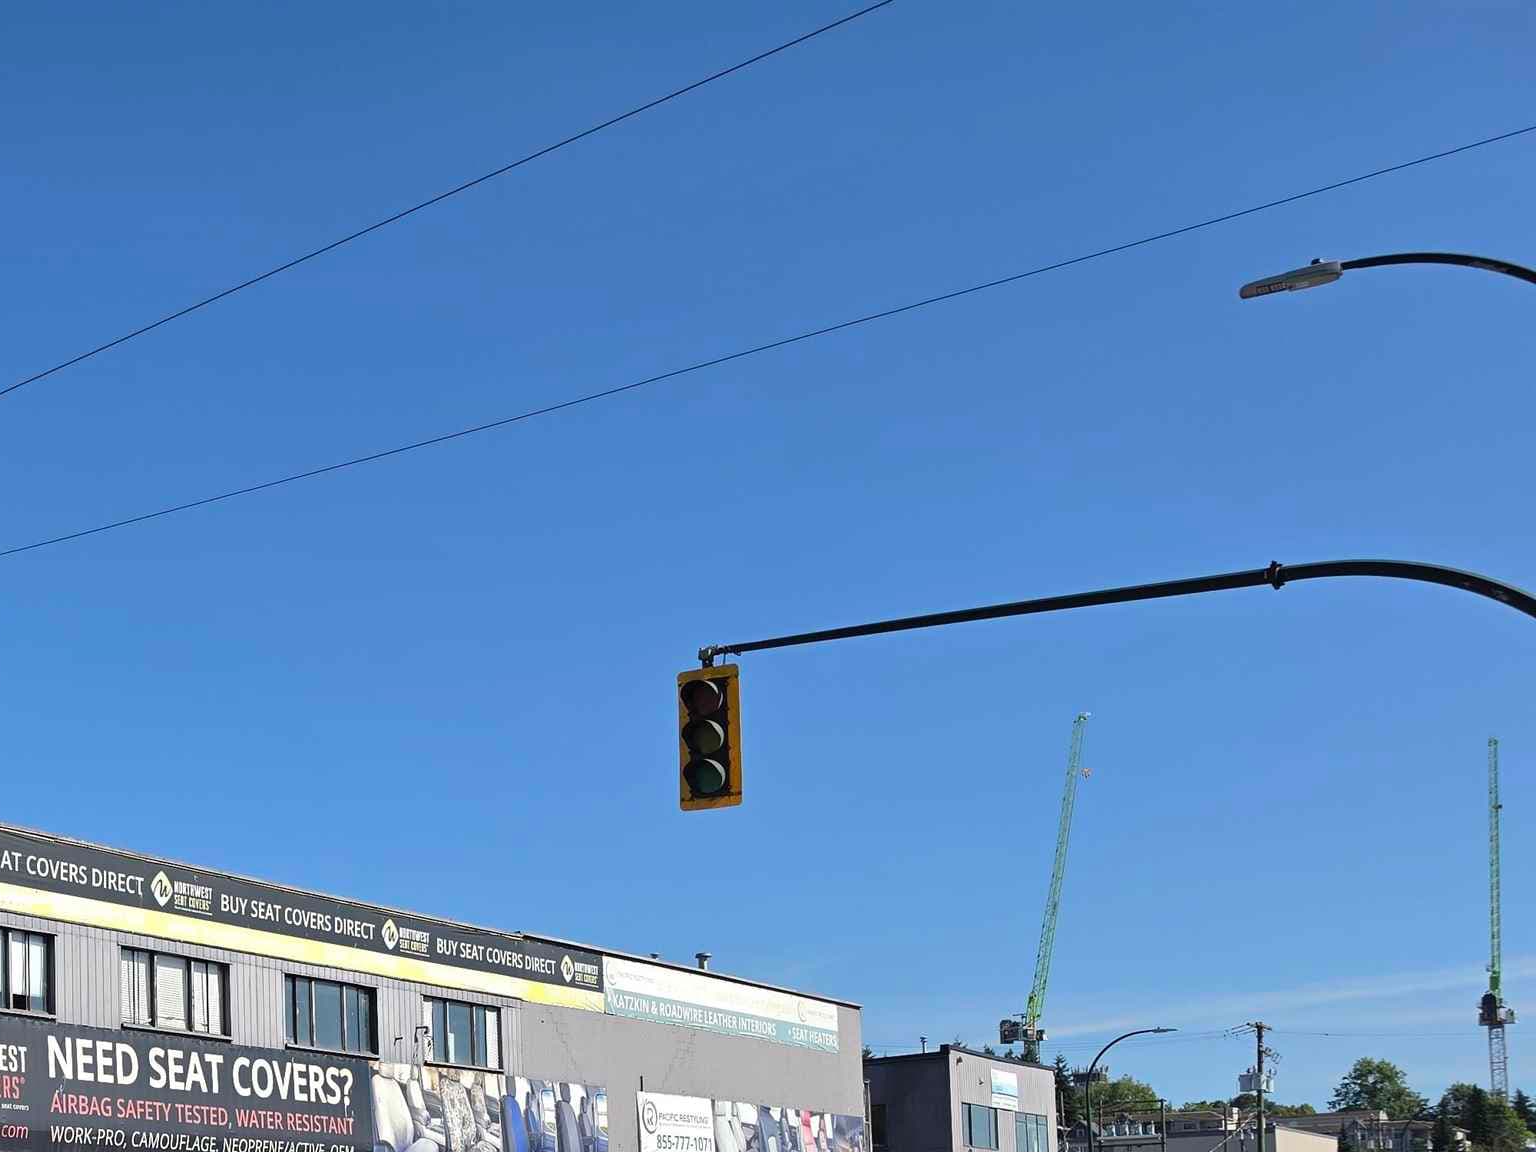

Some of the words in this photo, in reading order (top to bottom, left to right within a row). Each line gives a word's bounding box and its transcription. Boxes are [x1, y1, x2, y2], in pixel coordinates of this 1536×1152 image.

[26, 855, 88, 885] COVERS
[91, 866, 145, 895] DIRECT
[174, 880, 212, 900] NORTHWEST
[174, 895, 187, 906] SEAT
[188, 898, 210, 911] COVERS
[221, 893, 249, 915] BUY
[250, 900, 281, 922] SEAT
[284, 907, 332, 931] COVERS
[334, 917, 375, 941] DIRECT
[399, 927, 430, 943] NORTHWEST
[436, 936, 458, 956] BUY
[460, 943, 484, 962] SEAT
[486, 947, 523, 970] COVERS
[525, 955, 557, 976] DIRECT
[574, 962, 598, 975] NORTHWEST
[615, 995, 649, 1015] KATZKIN
[651, 1003, 658, 1014] &
[659, 1003, 703, 1023] ROADWIRE
[704, 1010, 737, 1028] LEATHER
[738, 1016, 776, 1035] INTERIORS
[791, 1027, 808, 1041] SEAT
[46, 1034, 140, 1086] NEED
[148, 1046, 224, 1096] SEAT
[232, 1056, 354, 1107] COVERS?
[49, 1092, 113, 1118] AIRBAG
[116, 1097, 171, 1123] SAFETY
[175, 1103, 232, 1130] TESTED,
[235, 1107, 284, 1131] WATER
[286, 1112, 354, 1136] RESISTANT
[658, 1112, 679, 1122] PACIFIC
[50, 1125, 127, 1150] WORK-PRO,
